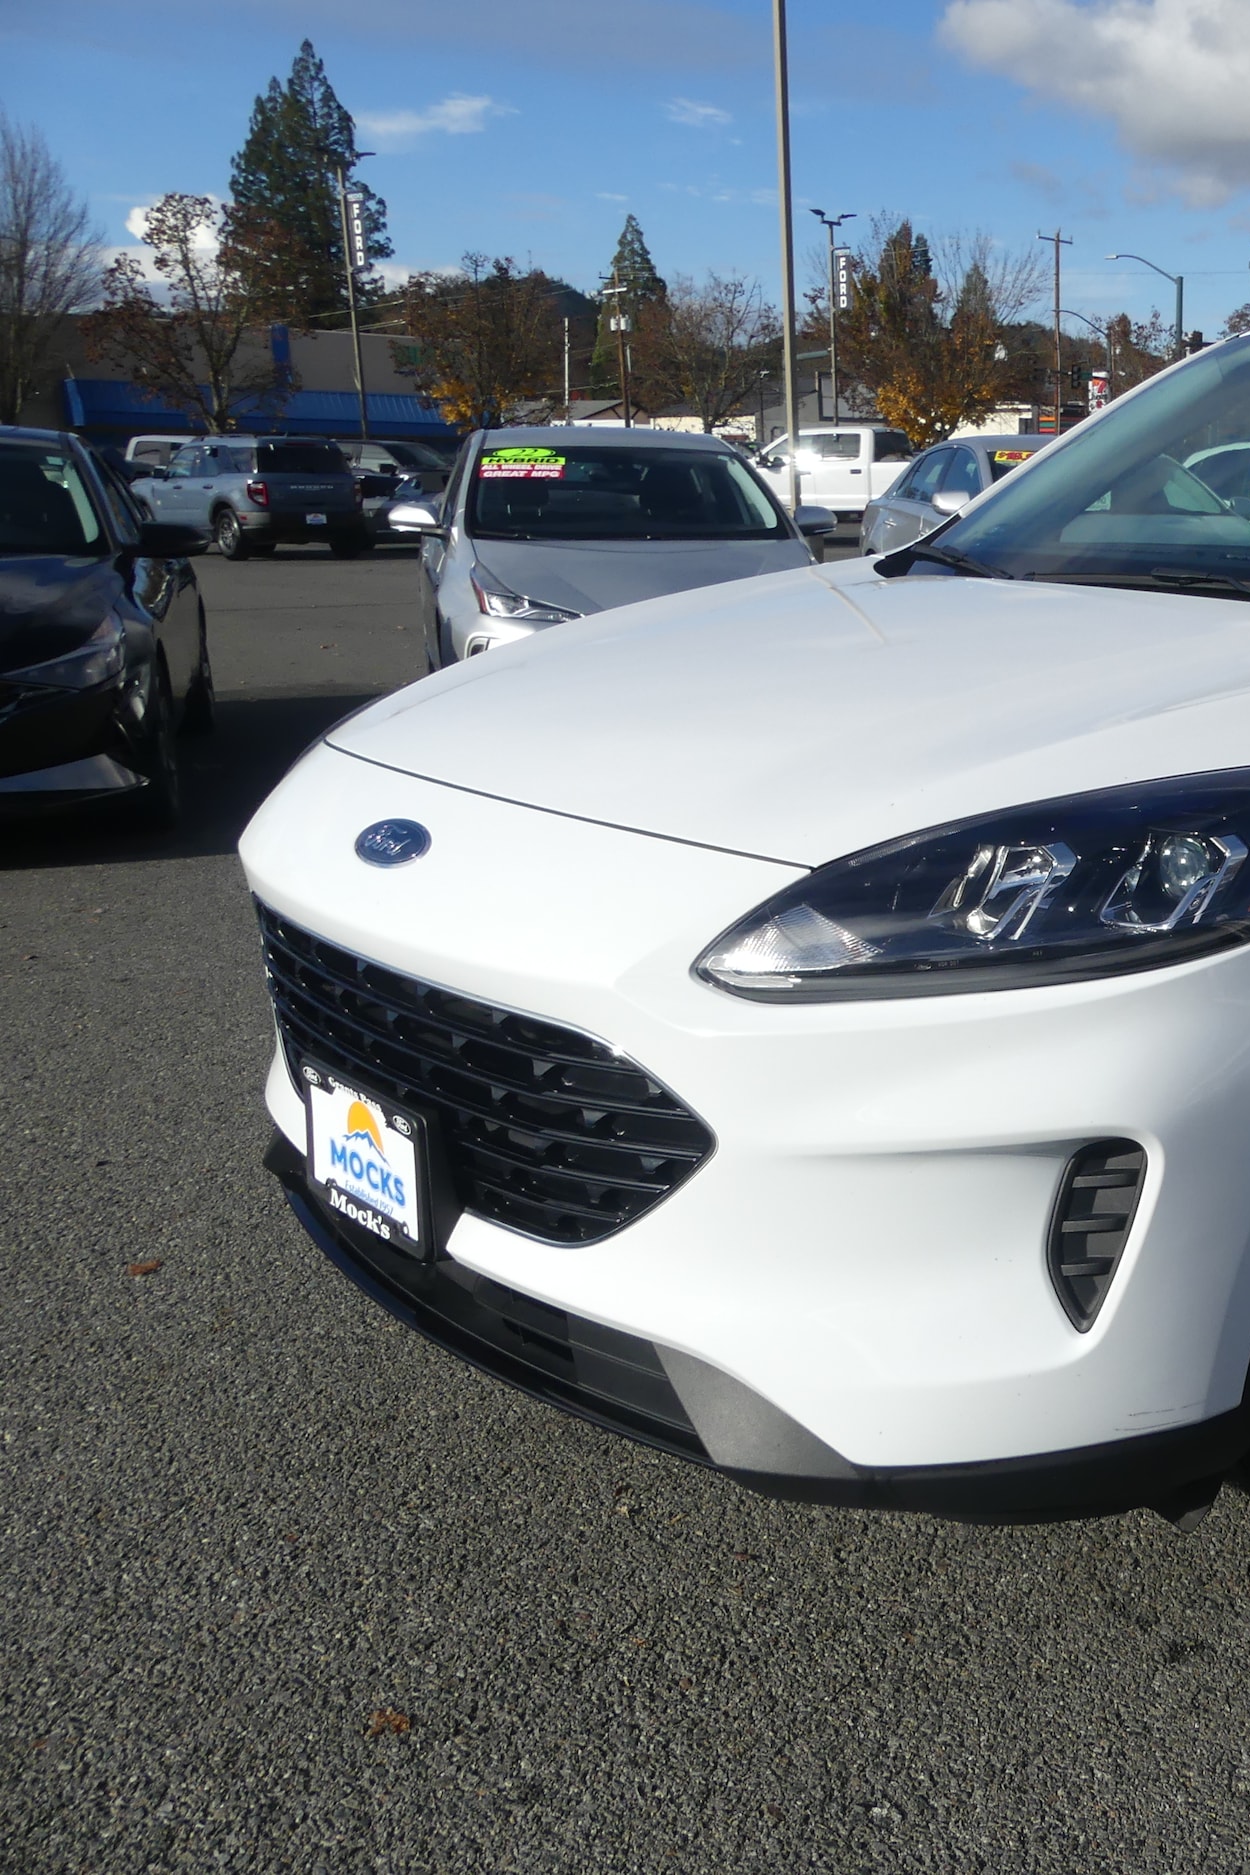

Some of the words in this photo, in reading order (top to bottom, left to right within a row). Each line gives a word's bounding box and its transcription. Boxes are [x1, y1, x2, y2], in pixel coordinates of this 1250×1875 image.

[352, 203, 365, 266] FORD
[839, 256, 848, 308] FORD
[483, 470, 528, 478] GREAT
[530, 470, 560, 478] MPG
[330, 1138, 406, 1207] MOCKS
[345, 1179, 379, 1208] Established
[330, 1188, 391, 1240] Mock's
